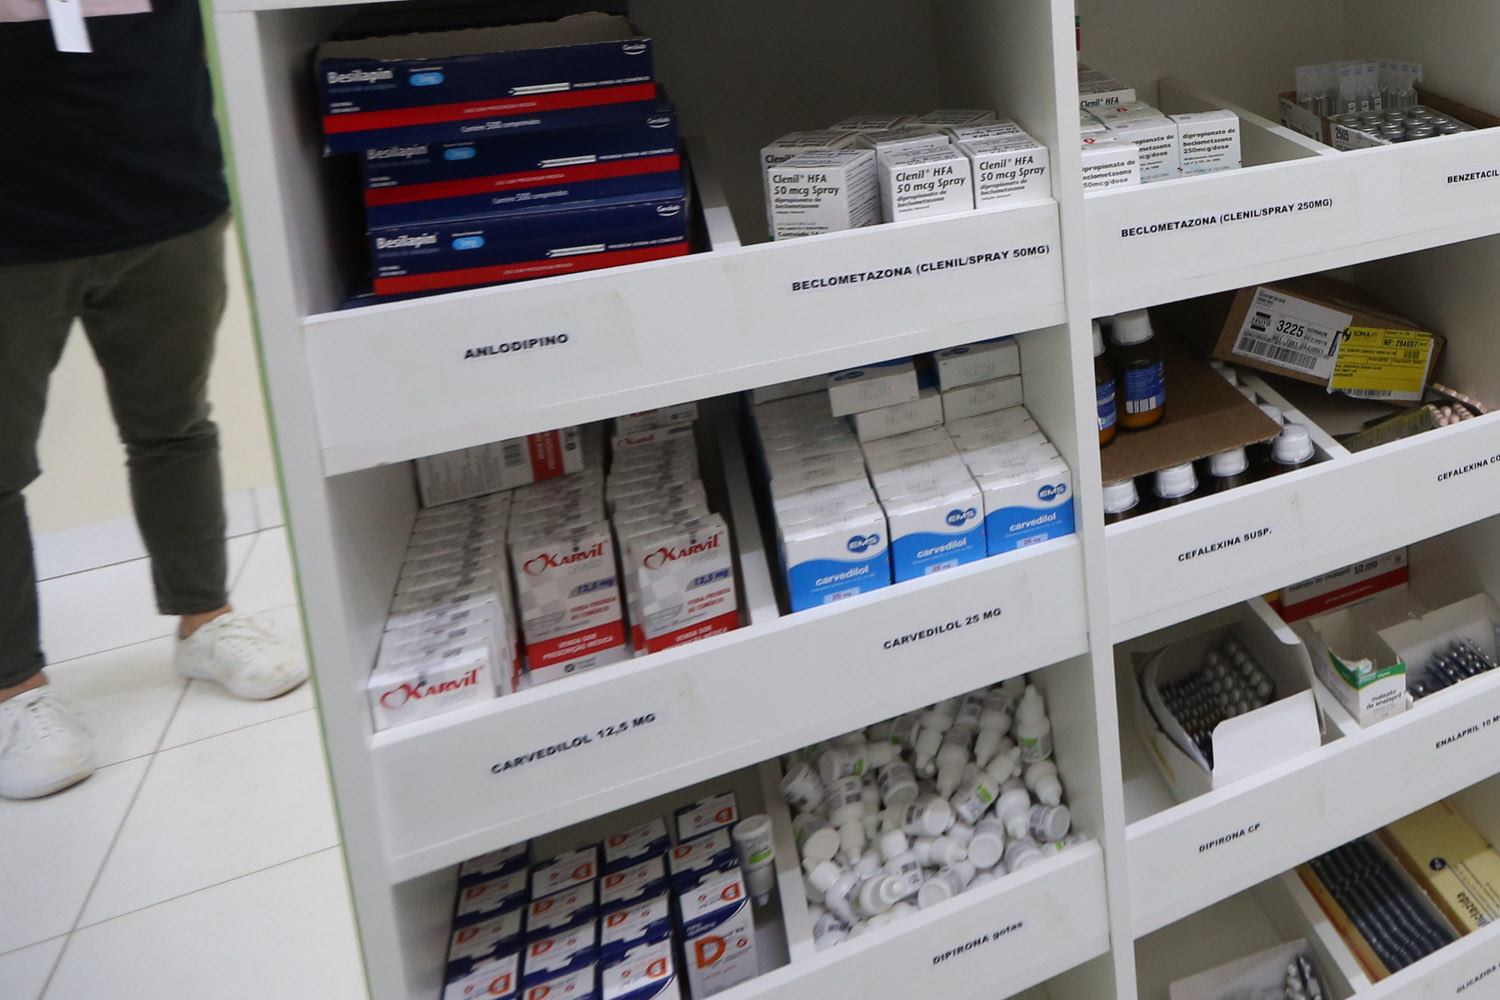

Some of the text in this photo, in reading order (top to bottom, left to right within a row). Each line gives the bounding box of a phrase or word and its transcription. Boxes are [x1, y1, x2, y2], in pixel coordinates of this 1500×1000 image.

[327, 67, 393, 85] Besilapin
[1335, 128, 1350, 142] 2505
[896, 165, 953, 182] Clenil HFA
[979, 156, 1034, 171] Clenil HFA
[980, 165, 1045, 182] 50 mcg Spray
[773, 174, 827, 184] Clenil HFA
[897, 175, 966, 193] 50 mcg Spray
[1447, 169, 1499, 184] BENZETACIL
[774, 185, 839, 196] 50 mcg Spray
[1121, 199, 1333, 238] BECLOMETAZONA (CLENIL/SPRAY 250MG)
[376, 232, 436, 250] Besilapin
[792, 245, 1050, 291] BECLOMETAZONA (CLENIL/SPRAY 50MG)
[1276, 320, 1305, 338] 3225
[463, 333, 569, 360] ANLODIPINO
[1437, 458, 1488, 482] CEFALEXINA
[1009, 512, 1056, 533] carvedilol
[917, 538, 966, 558] carvedilol
[1178, 528, 1272, 562] CEFALEXINA SUSP.
[815, 565, 869, 587] carvedilol
[883, 608, 1002, 650] CARVEDILOL 25 MG
[491, 712, 656, 774] CARVEDILOL 12,5 MG
[1435, 724, 1480, 749] ENALAPRIL
[1482, 719, 1491, 727] 10
[1198, 823, 1261, 853] DIPIRONA CP
[695, 935, 726, 969] D
[932, 919, 1024, 966] DIPIRONA gotas
